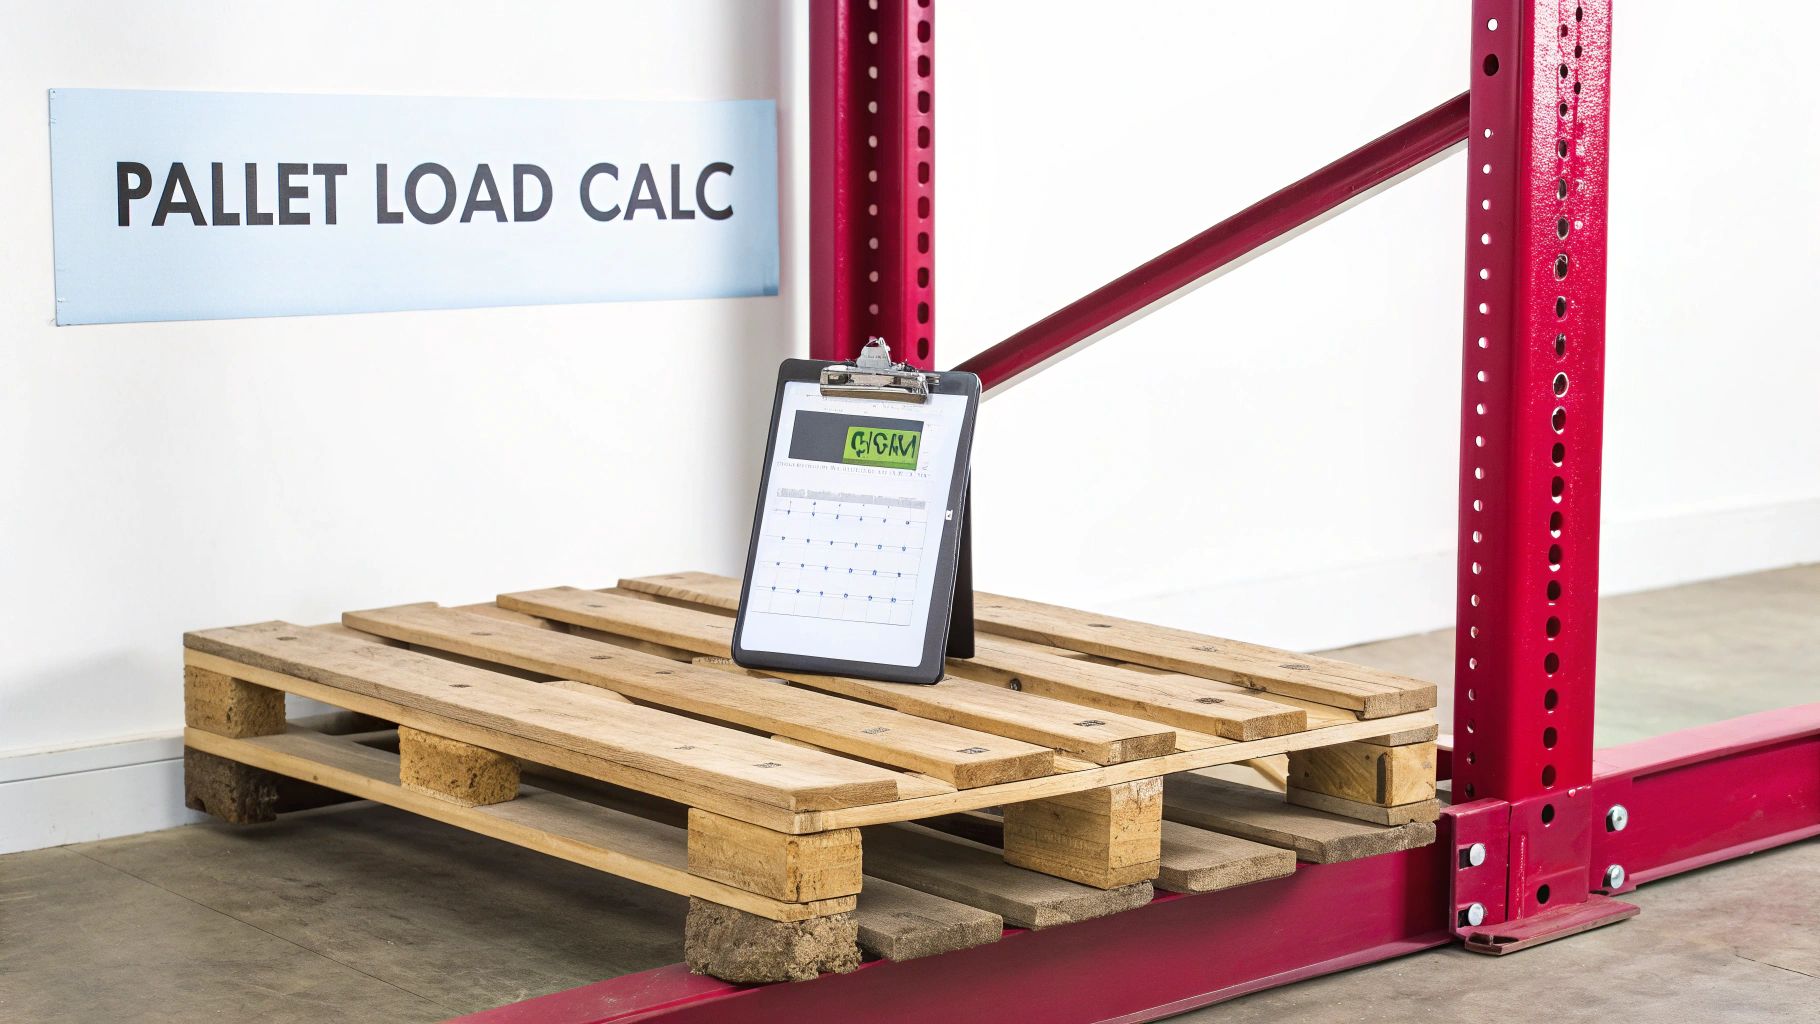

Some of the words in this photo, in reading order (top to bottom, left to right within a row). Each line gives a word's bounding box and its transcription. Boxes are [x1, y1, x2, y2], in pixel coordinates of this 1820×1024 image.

[116, 162, 348, 227] PALLET
[376, 162, 553, 225] LOAD
[580, 162, 735, 222] CALC
